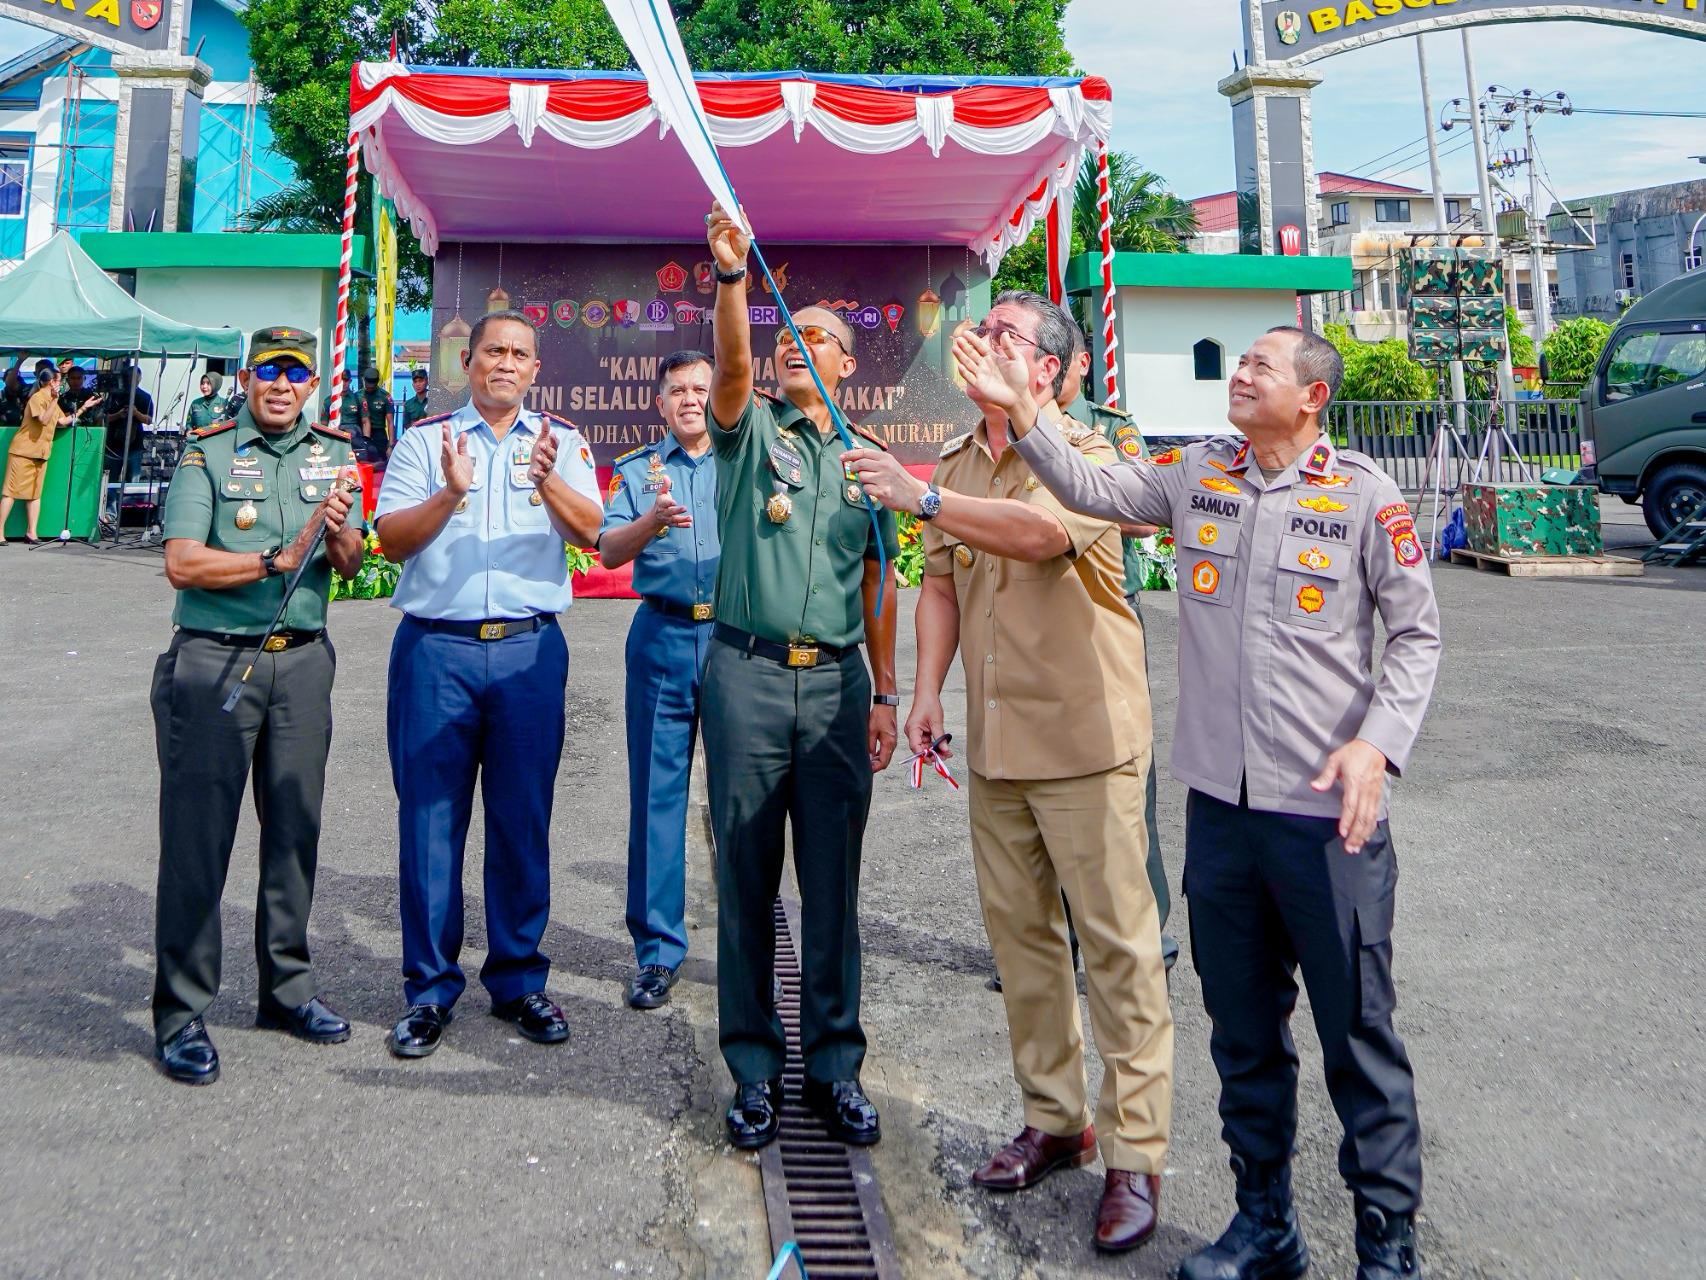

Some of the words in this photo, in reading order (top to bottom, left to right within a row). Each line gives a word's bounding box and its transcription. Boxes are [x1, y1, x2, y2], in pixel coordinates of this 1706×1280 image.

[752, 308, 778, 322] BRI
[600, 357, 663, 380] “KAM
[570, 386, 651, 410] SELALU
[576, 425, 643, 444] ADHAN
[1190, 494, 1240, 518] SAMUDI
[1380, 504, 1408, 521] POLDA
[1290, 516, 1347, 541] POLRI
